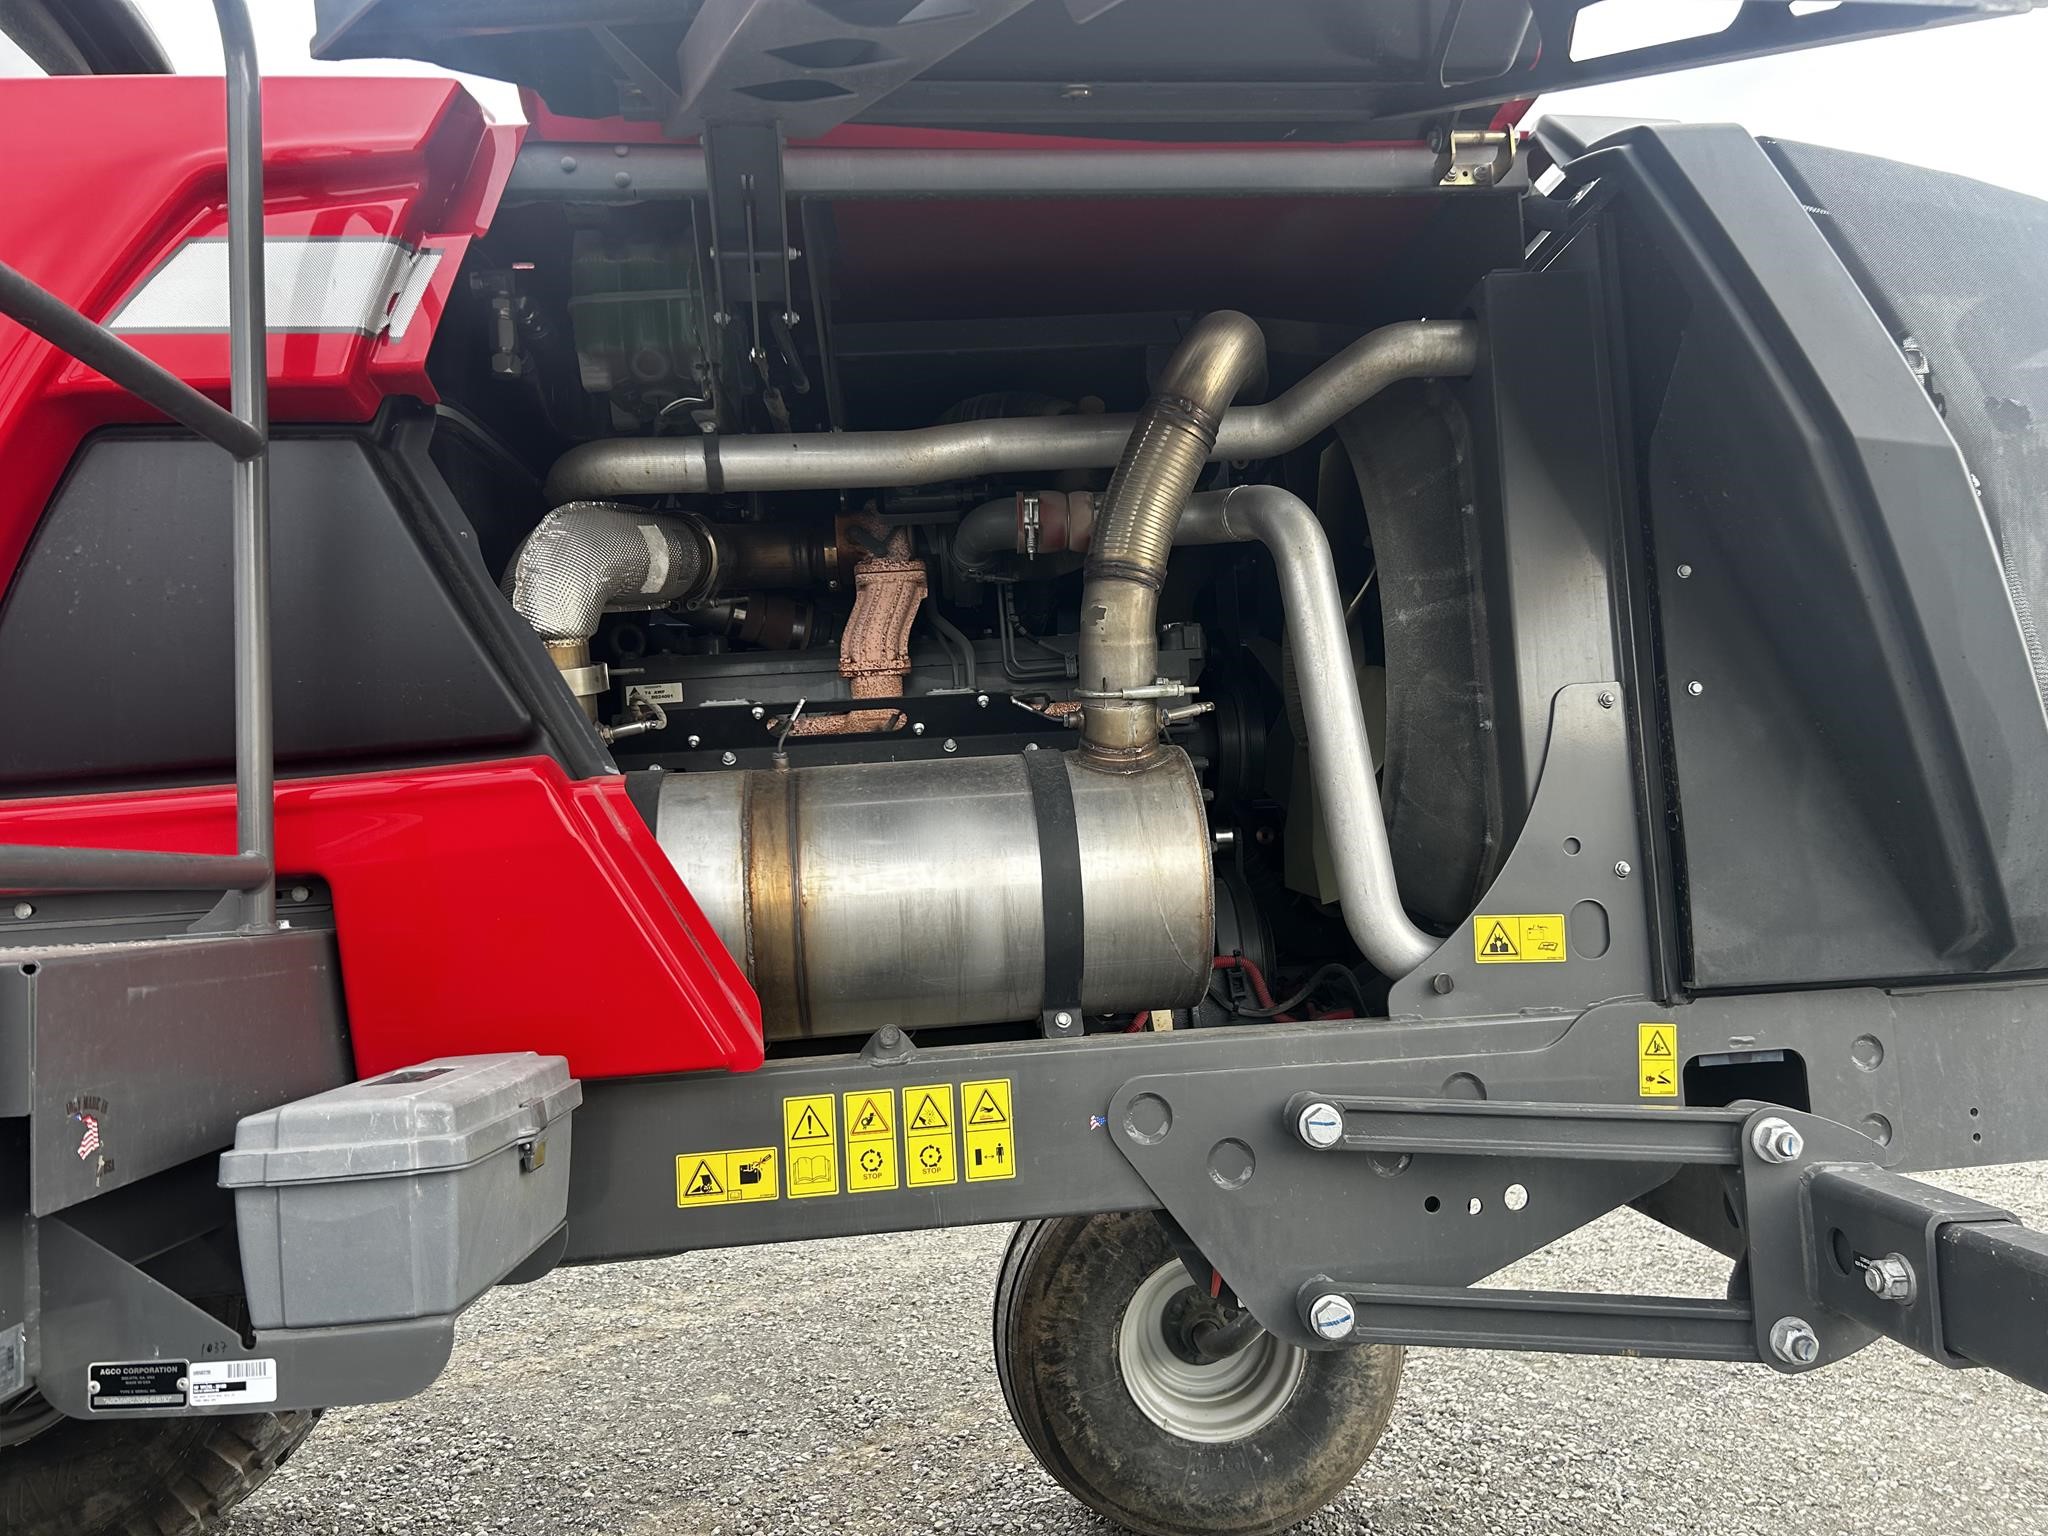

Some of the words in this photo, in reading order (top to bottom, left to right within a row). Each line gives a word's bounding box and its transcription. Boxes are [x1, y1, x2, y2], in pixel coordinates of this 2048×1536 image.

[922, 1167, 941, 1175] STOP
[863, 1172, 882, 1180] STOP
[122, 1366, 178, 1375] CORPORATION
